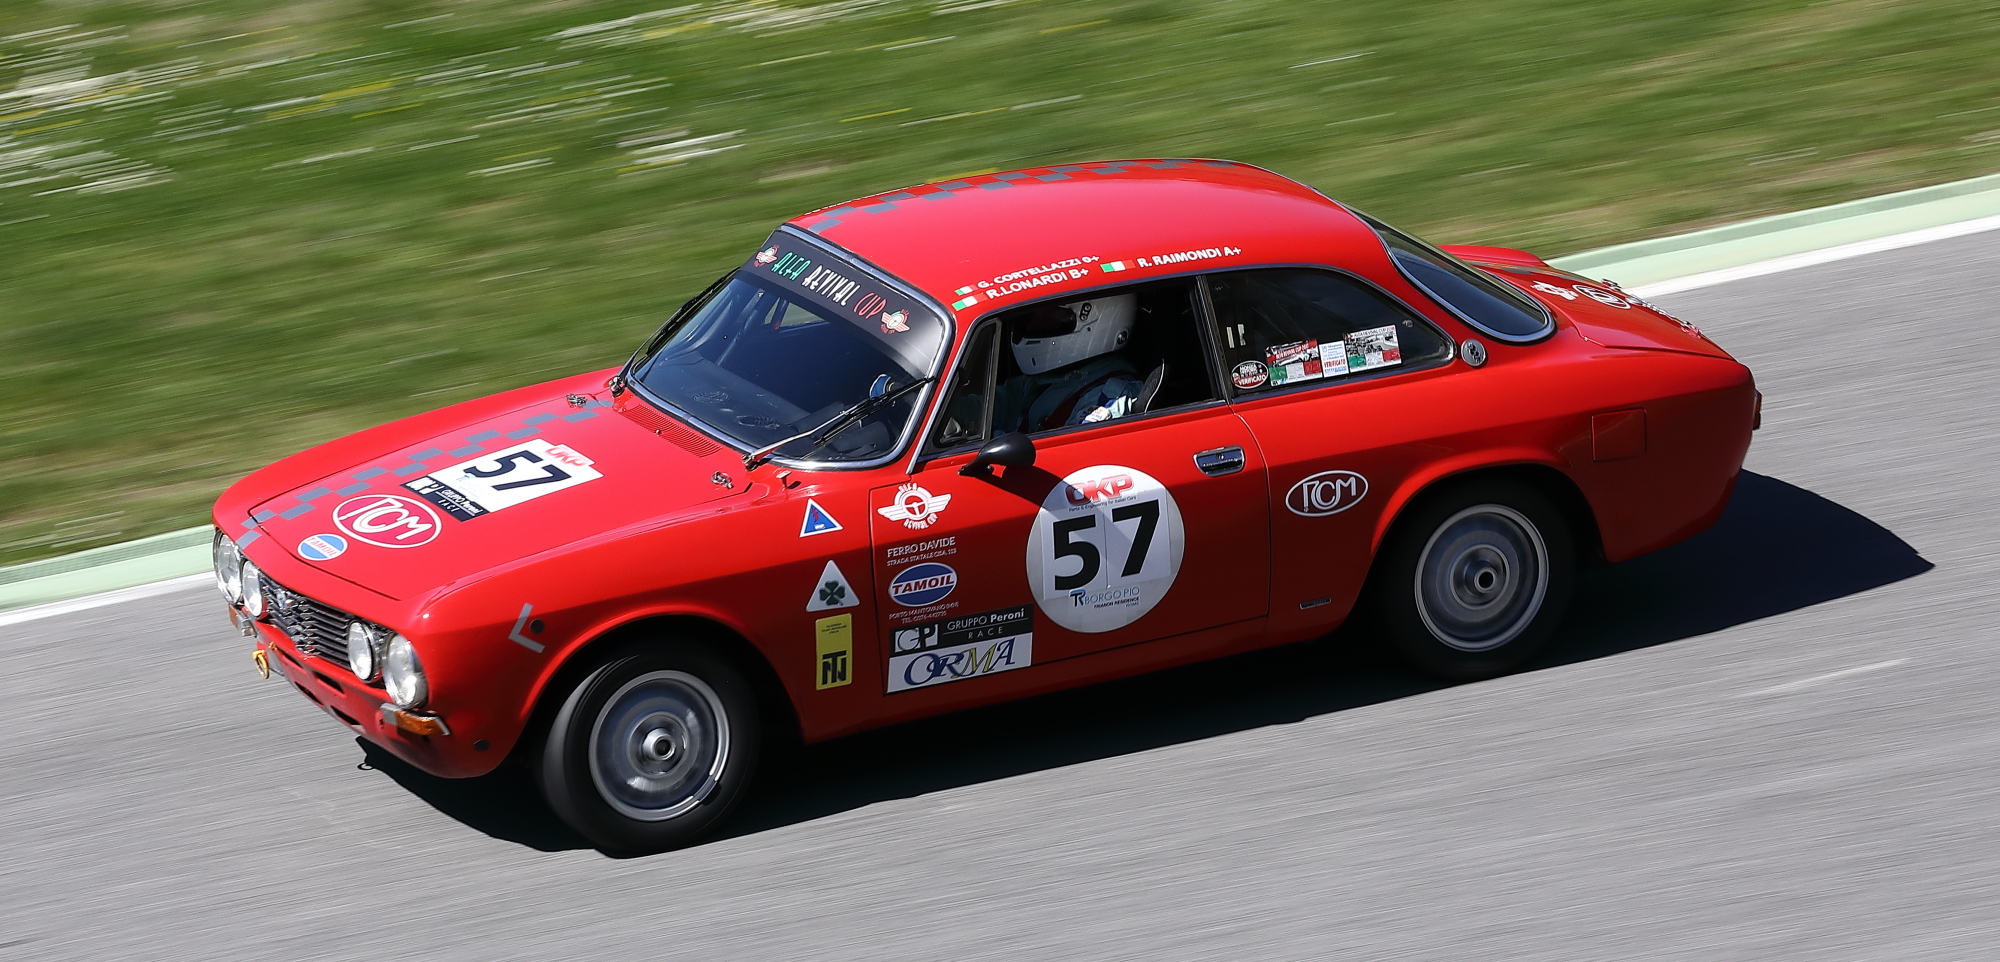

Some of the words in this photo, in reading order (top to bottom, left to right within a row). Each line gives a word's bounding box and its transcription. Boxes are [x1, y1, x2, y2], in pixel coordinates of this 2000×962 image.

[1138, 258, 1153, 268] R.
[1155, 248, 1222, 266] RAIMONDI
[1224, 246, 1242, 256] A+
[977, 280, 992, 288] G.
[994, 259, 1081, 284] CORTELLAZZI
[1070, 268, 1089, 280] B+
[771, 252, 811, 280] ALFA
[802, 265, 860, 306] REVIVAL
[854, 292, 887, 320] CUP
[1324, 358, 1346, 368] VERIFICATO
[1238, 374, 1266, 385] VERIFICATO
[463, 450, 572, 491] 57
[1064, 474, 1134, 505] OKP
[308, 537, 337, 556] TAMOIL
[887, 544, 918, 558] FERRO
[920, 536, 956, 552] DAVIDE
[1053, 499, 1160, 590] 57
[886, 555, 909, 566] STRADA
[910, 550, 934, 562] STATALE
[892, 574, 954, 594] TAMOIL
[1084, 590, 1122, 605] BORGO
[1124, 586, 1140, 599] PIO
[888, 609, 908, 620] PORTO
[947, 616, 987, 632] GRUPPO
[990, 608, 1024, 623] Peroni
[968, 626, 1004, 640] RACE
[904, 636, 1016, 686] ORMA
